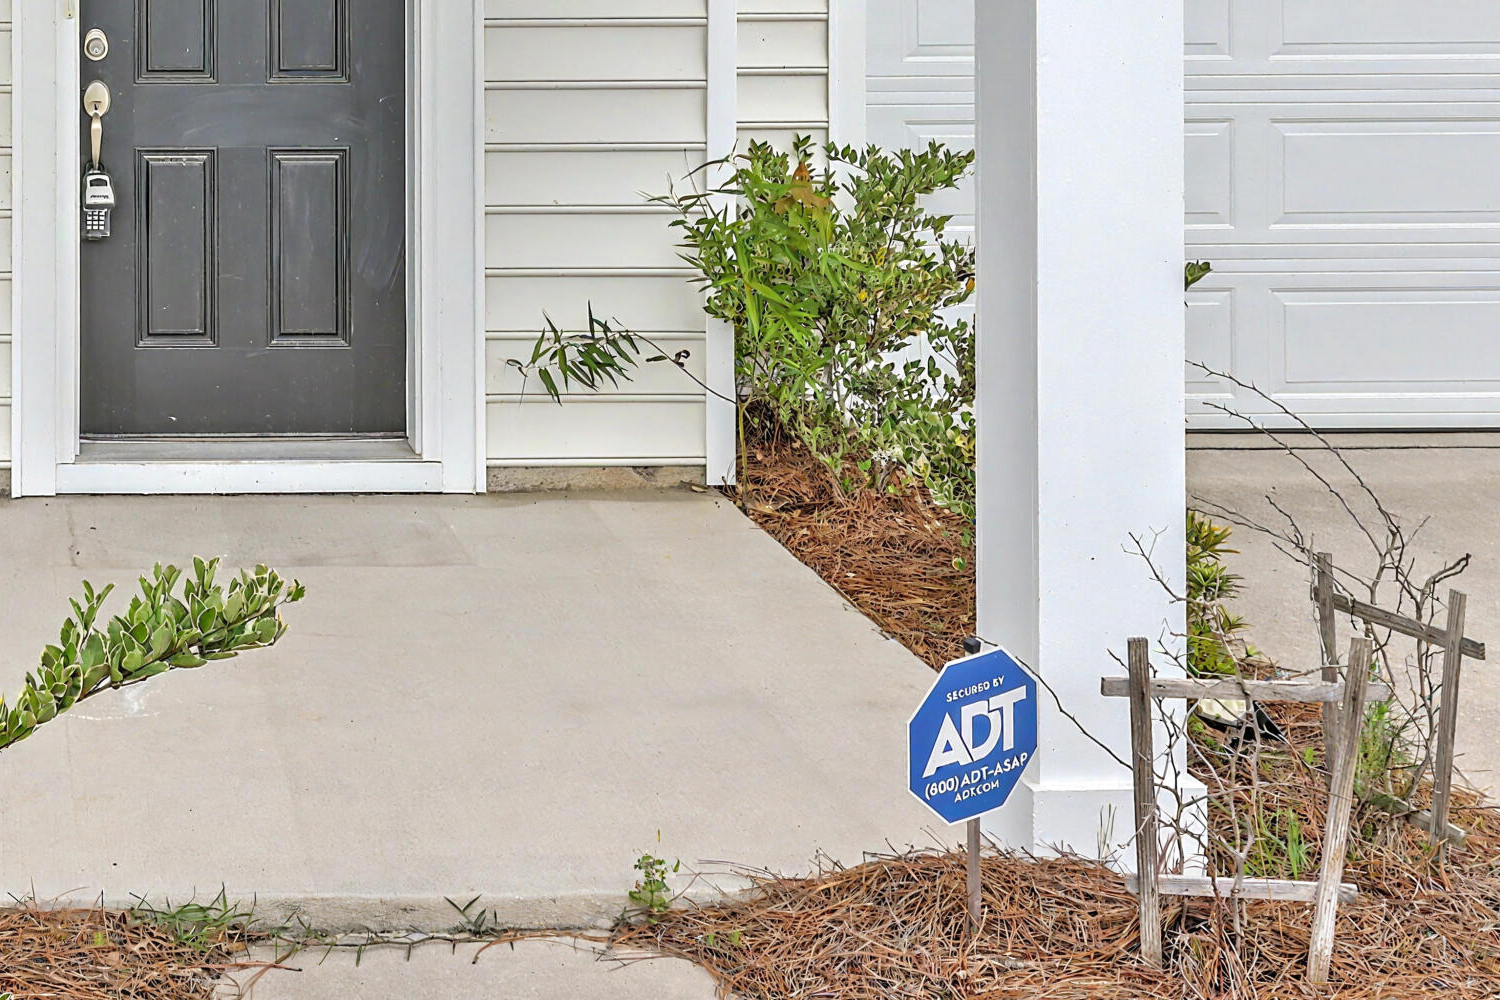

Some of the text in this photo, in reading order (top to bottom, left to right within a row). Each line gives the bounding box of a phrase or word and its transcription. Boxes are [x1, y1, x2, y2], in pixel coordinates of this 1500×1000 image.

[946, 675, 1005, 703] SECURED BY
[922, 684, 1027, 779] ADT
